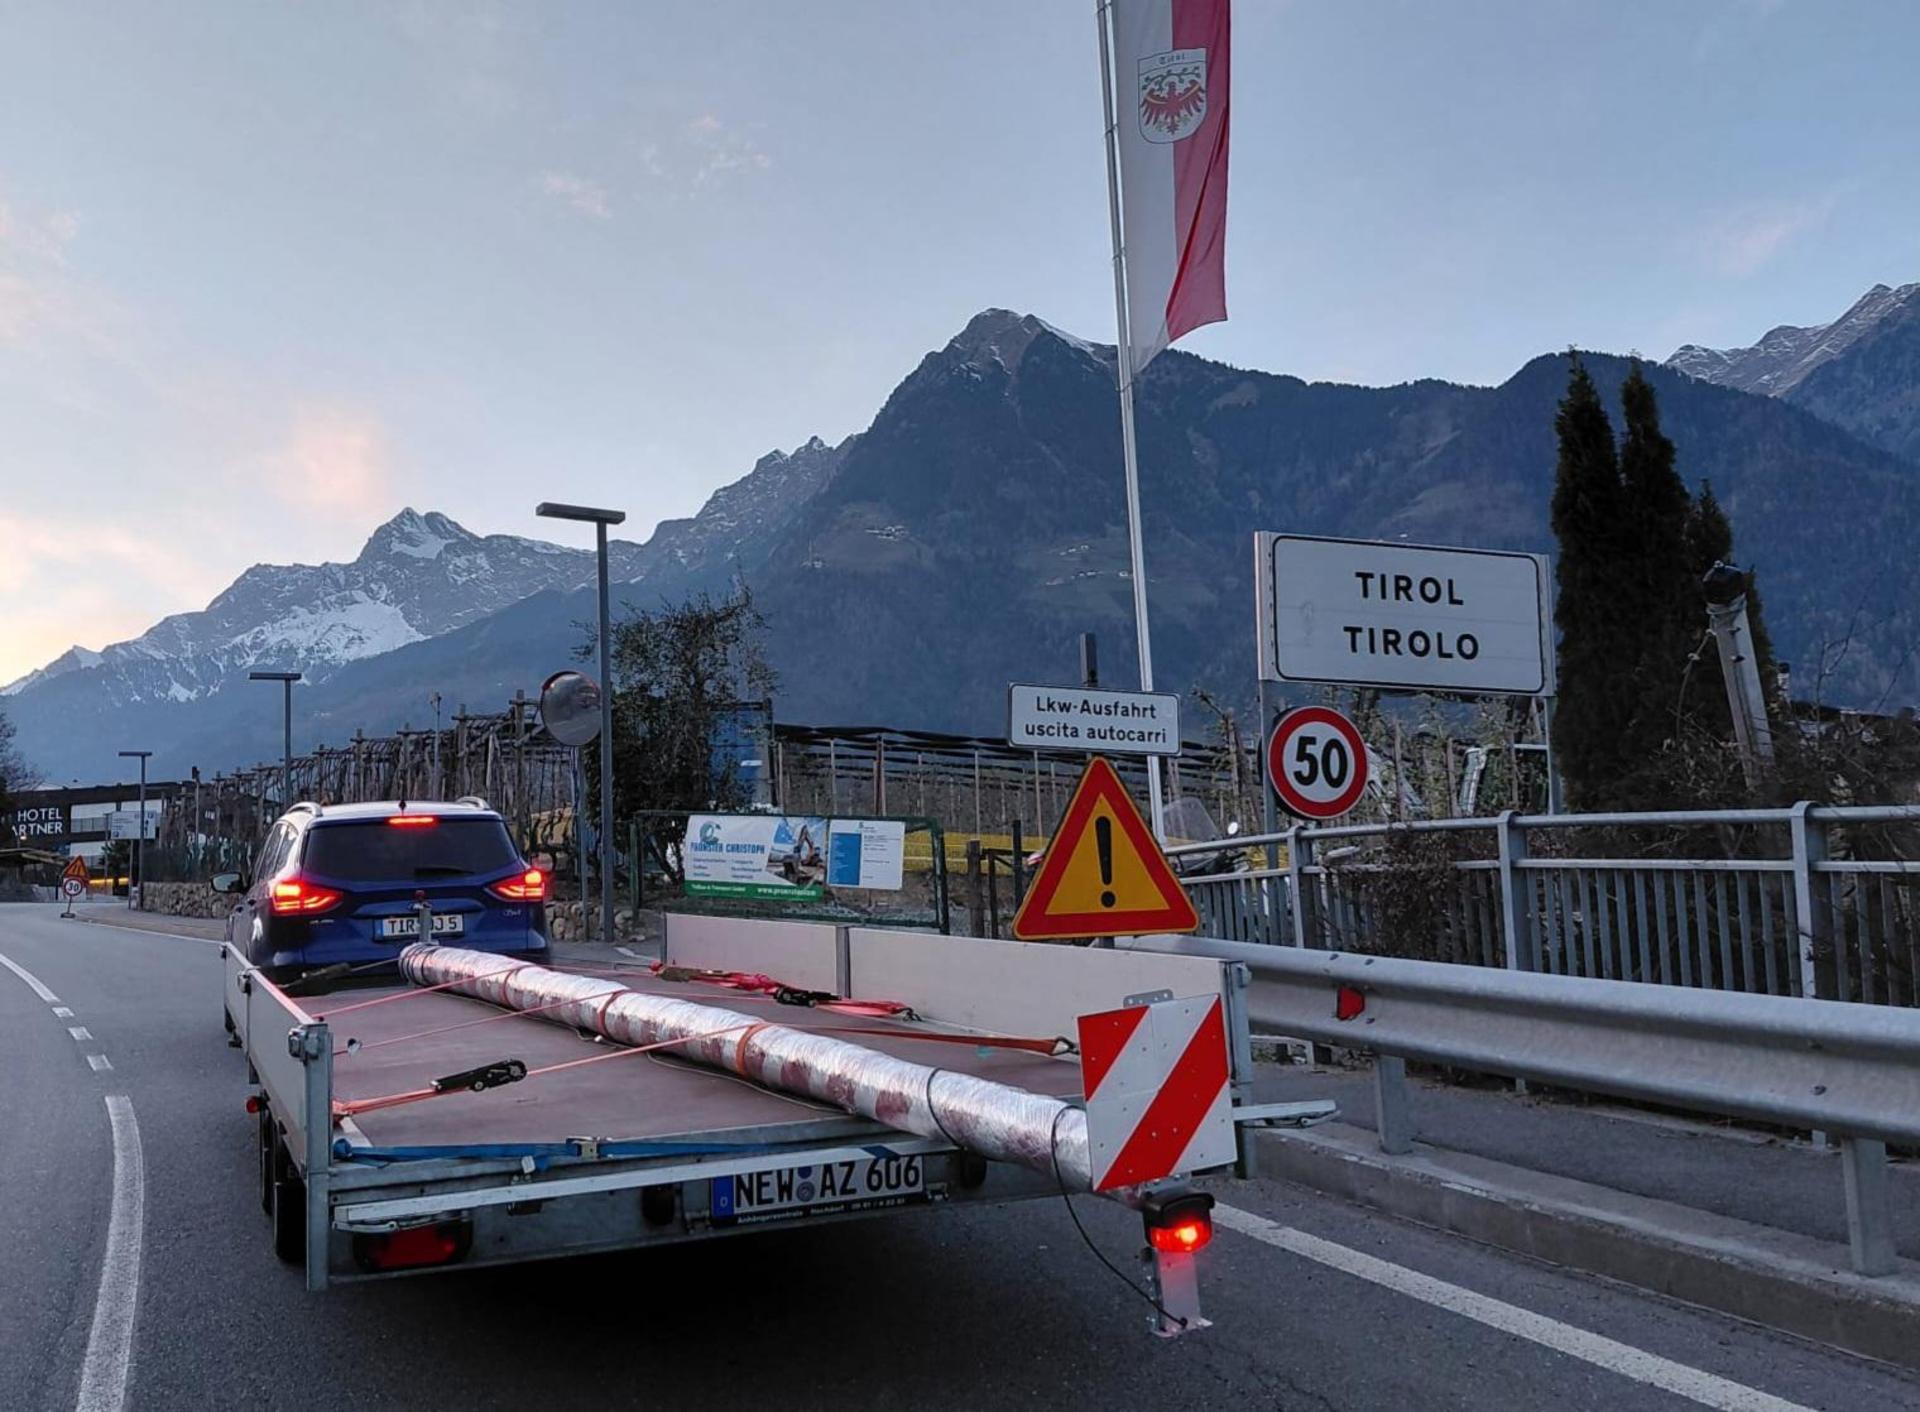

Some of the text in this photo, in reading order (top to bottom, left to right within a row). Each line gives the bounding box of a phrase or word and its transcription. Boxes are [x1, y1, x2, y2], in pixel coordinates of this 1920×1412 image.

[1355, 571, 1464, 606] TIROL
[1343, 626, 1479, 660] TIROLO
[1036, 696, 1157, 719] Lkw-Ausfahrt
[1025, 722, 1167, 744] uscita autocarri
[1293, 735, 1349, 789] 50
[17, 807, 63, 823] HOTEL
[68, 882, 79, 892] 30
[388, 919, 415, 933] TIR
[735, 1155, 920, 1208] NEW AZ 606
